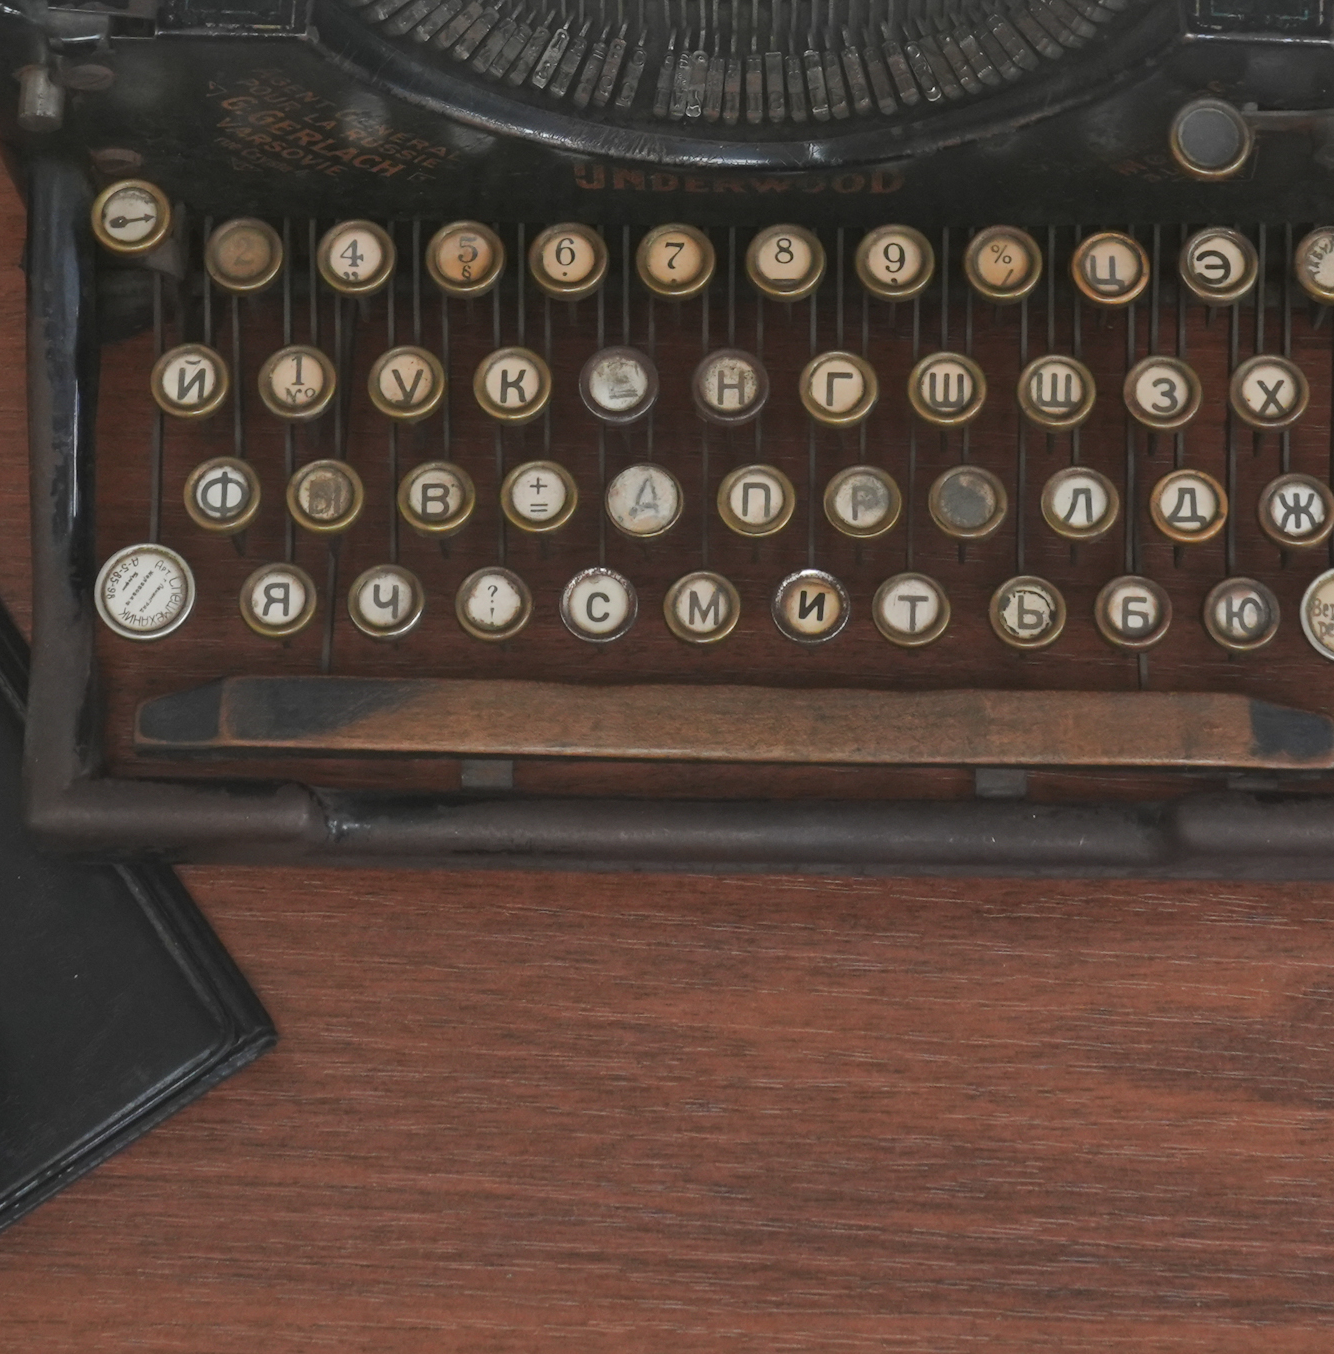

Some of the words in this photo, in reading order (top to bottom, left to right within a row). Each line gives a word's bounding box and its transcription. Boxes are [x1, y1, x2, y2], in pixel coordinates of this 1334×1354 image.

[248, 109, 407, 178] GERLACH
[573, 163, 906, 195] UNDERWOOD
[555, 237, 576, 266] 6
[665, 241, 685, 270] 7
[775, 237, 795, 264] 8
[882, 242, 907, 274] 9
[1196, 249, 1232, 285] Э
[1090, 253, 1125, 290] Ц
[178, 358, 208, 401] Й
[391, 368, 425, 405] У
[500, 368, 527, 404] К
[827, 372, 854, 407] Г
[1256, 378, 1288, 416] Х
[200, 470, 248, 519] Ф
[420, 482, 450, 520] В
[741, 481, 771, 517] П
[1066, 487, 1095, 524] Л
[1167, 486, 1207, 523] Д
[1278, 492, 1317, 532] Ж
[262, 581, 291, 618] Я
[372, 583, 400, 620] Ч
[798, 590, 827, 622] И
[1121, 596, 1150, 632] Б
[1224, 596, 1264, 633] Ю
